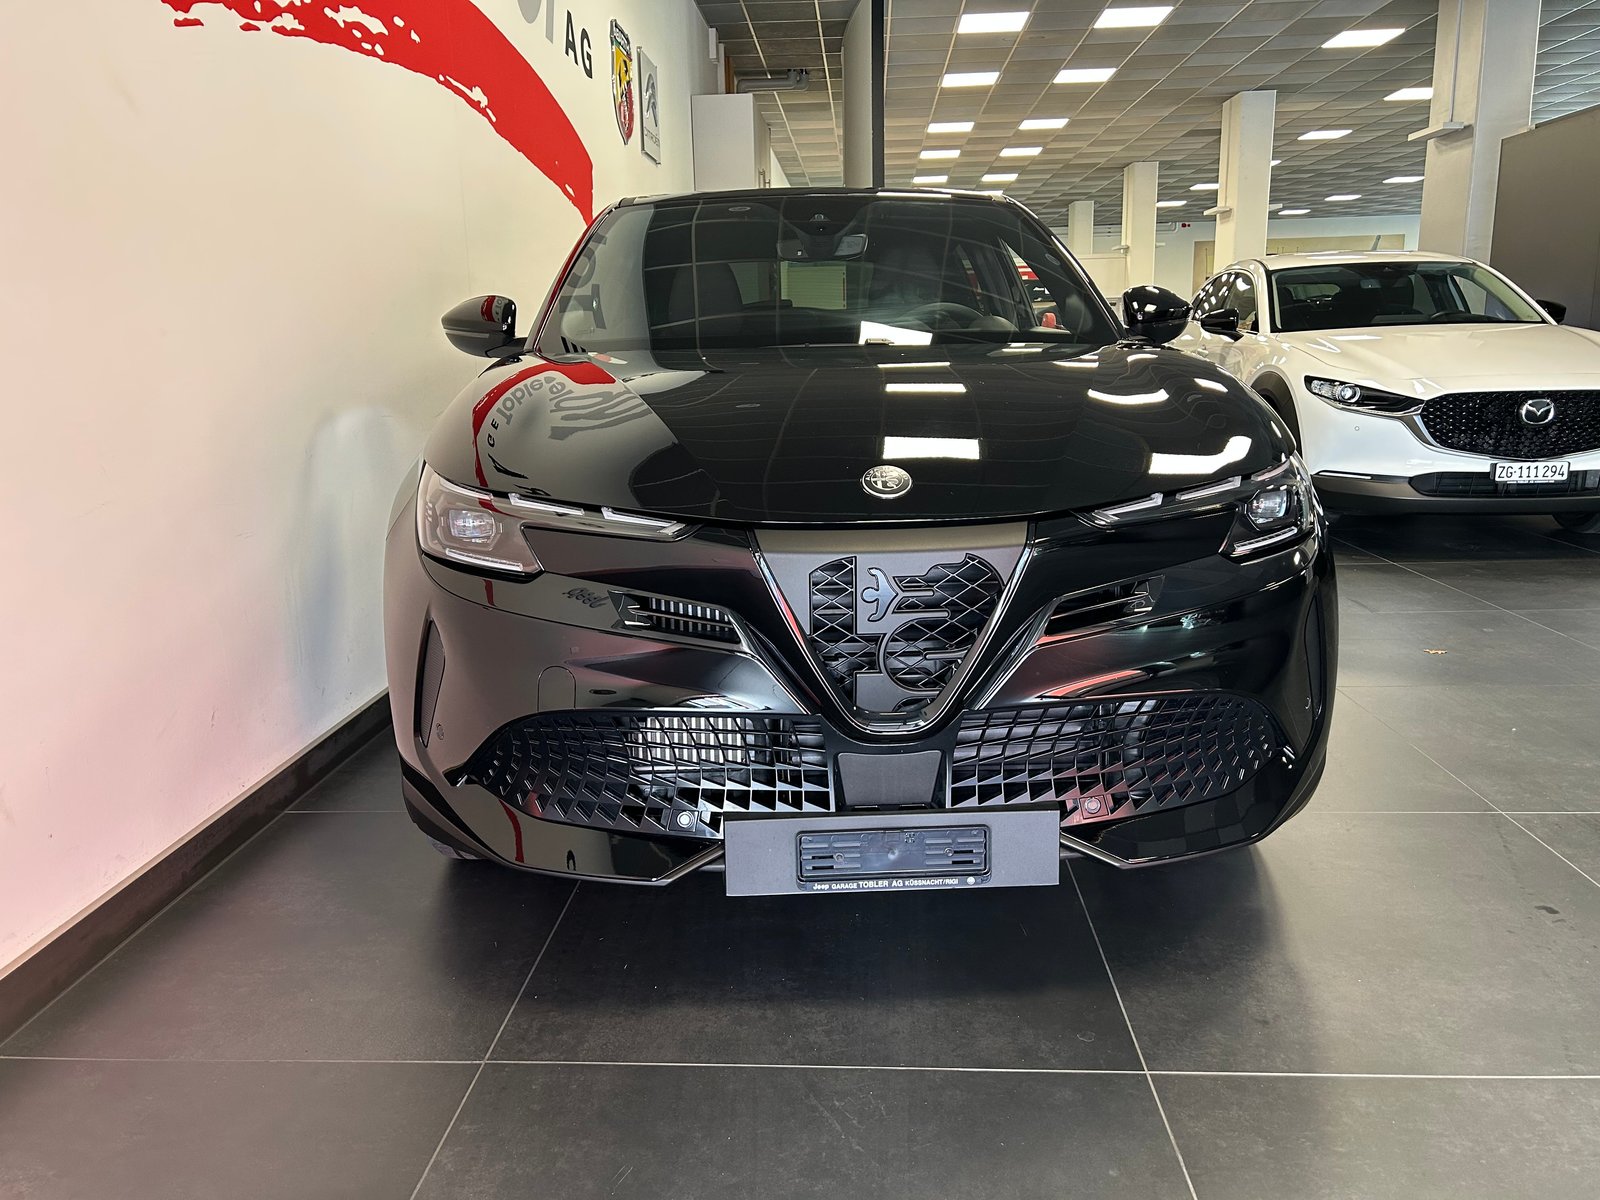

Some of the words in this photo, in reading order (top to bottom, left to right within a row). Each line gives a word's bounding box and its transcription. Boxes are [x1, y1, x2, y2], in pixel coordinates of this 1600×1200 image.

[565, 9, 593, 79] AG
[831, 882, 857, 890] GARAGE
[859, 880, 889, 888] TOBLER
[892, 879, 903, 887] AG
